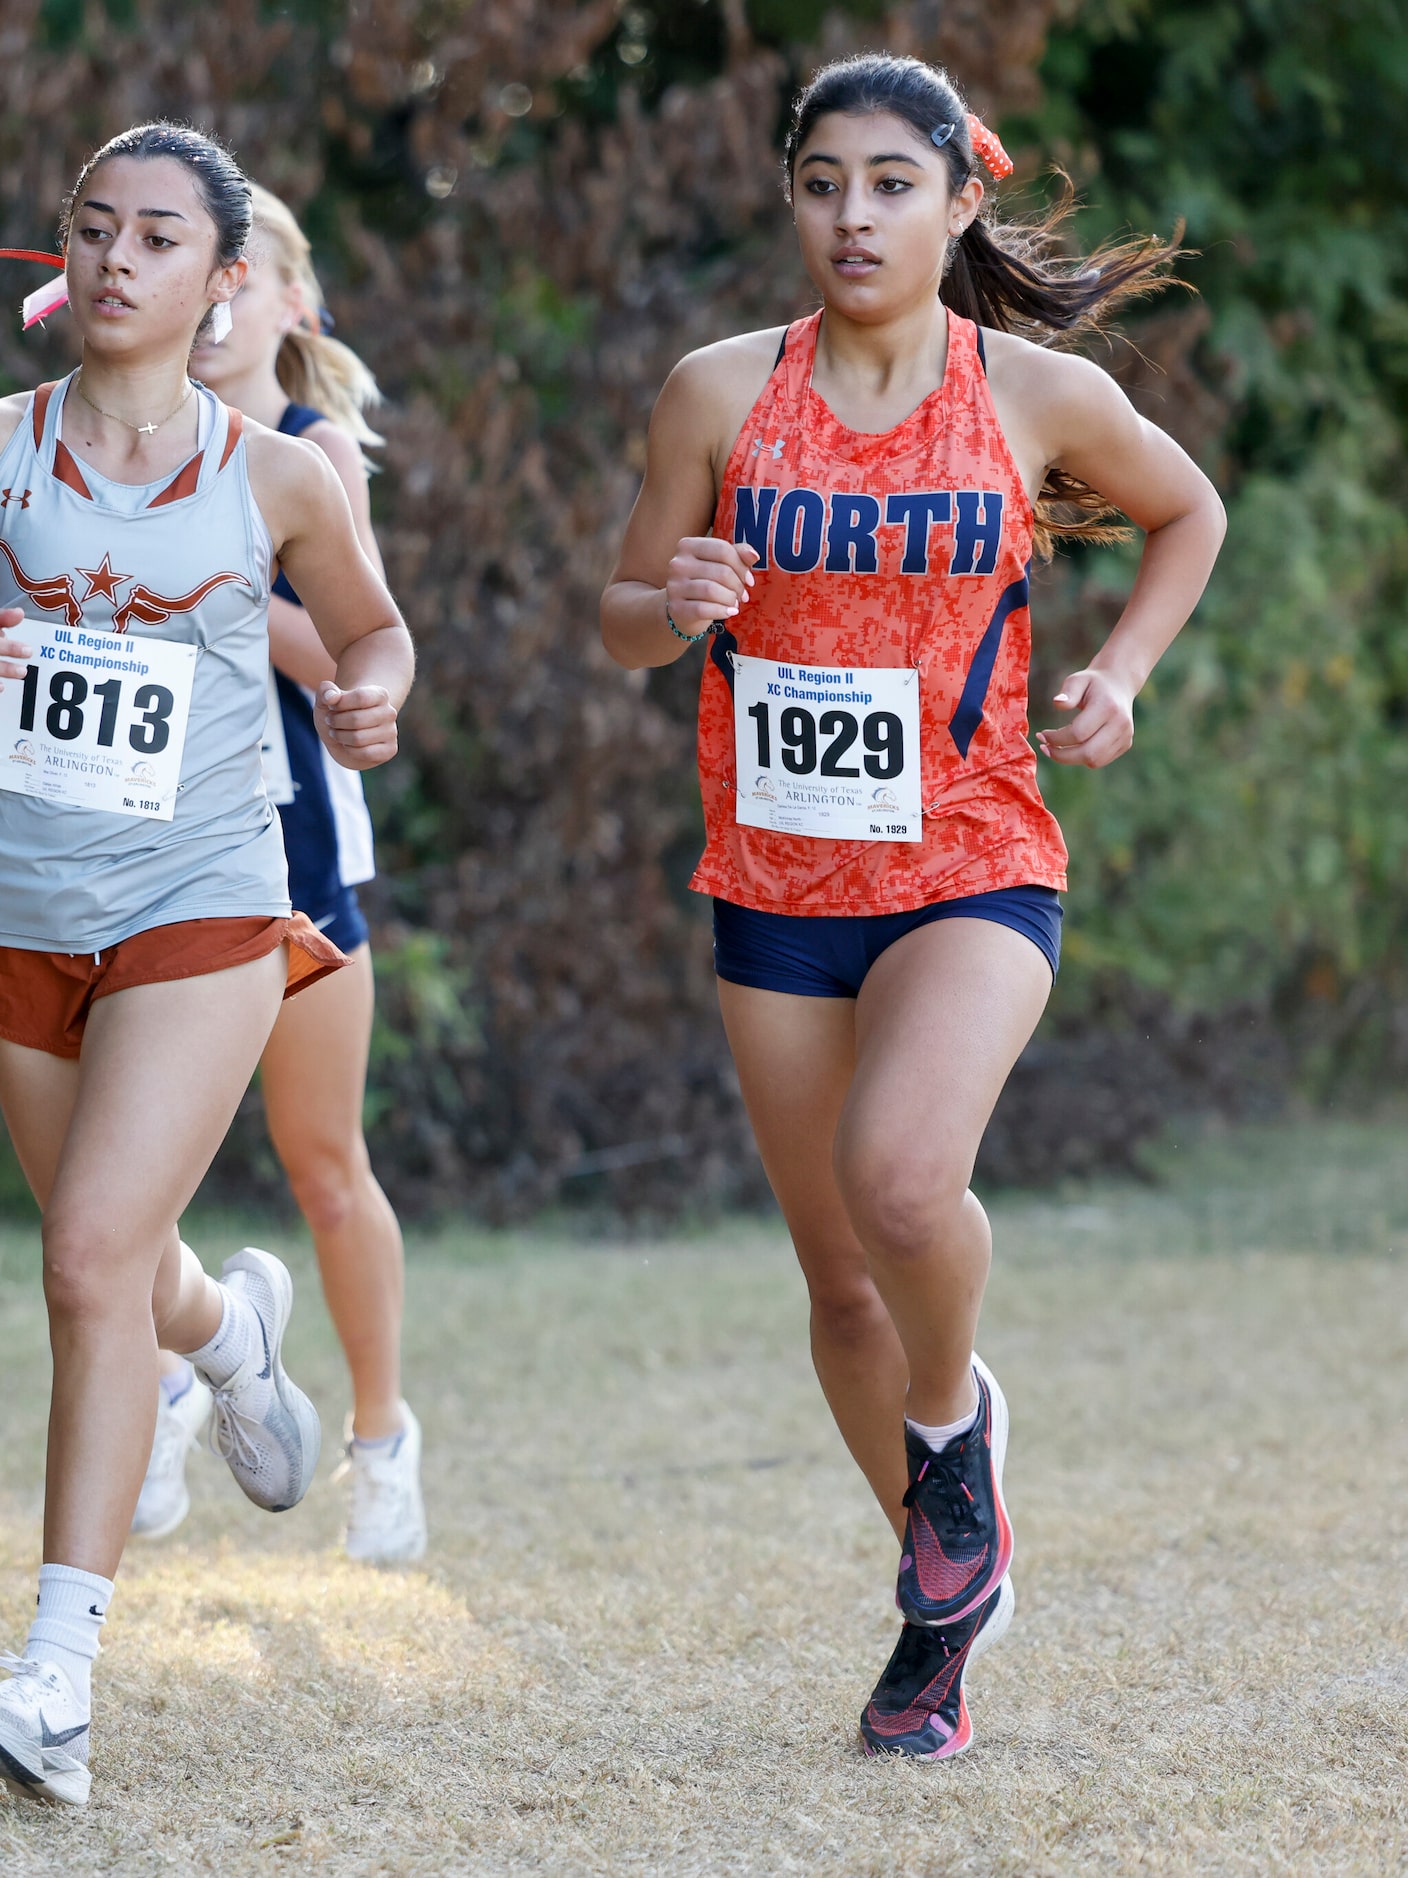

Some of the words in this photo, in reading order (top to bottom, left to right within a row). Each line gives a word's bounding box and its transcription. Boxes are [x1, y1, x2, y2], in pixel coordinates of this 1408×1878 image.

[733, 486, 1004, 577] NORTH
[55, 630, 74, 644] UIL
[78, 633, 122, 651] Region
[40, 645, 55, 660] XC
[58, 649, 149, 676] Championship
[778, 667, 795, 680] UIL
[799, 669, 841, 685] Region
[767, 683, 781, 696] XC
[784, 686, 873, 705] Championship
[20, 664, 175, 754] 1813
[748, 701, 904, 780] 1929
[40, 743, 52, 753] The
[54, 746, 89, 761] University
[90, 753, 100, 762] of
[102, 755, 123, 766] Texas
[44, 755, 114, 777] ARLINGTON
[778, 779, 791, 788] The
[792, 782, 828, 793] University
[841, 786, 863, 794] Texas
[122, 797, 136, 808] No.
[139, 800, 160, 811] 1813
[785, 790, 855, 806] ARLINGTON
[869, 824, 883, 834] No.
[886, 824, 907, 834] 1929
